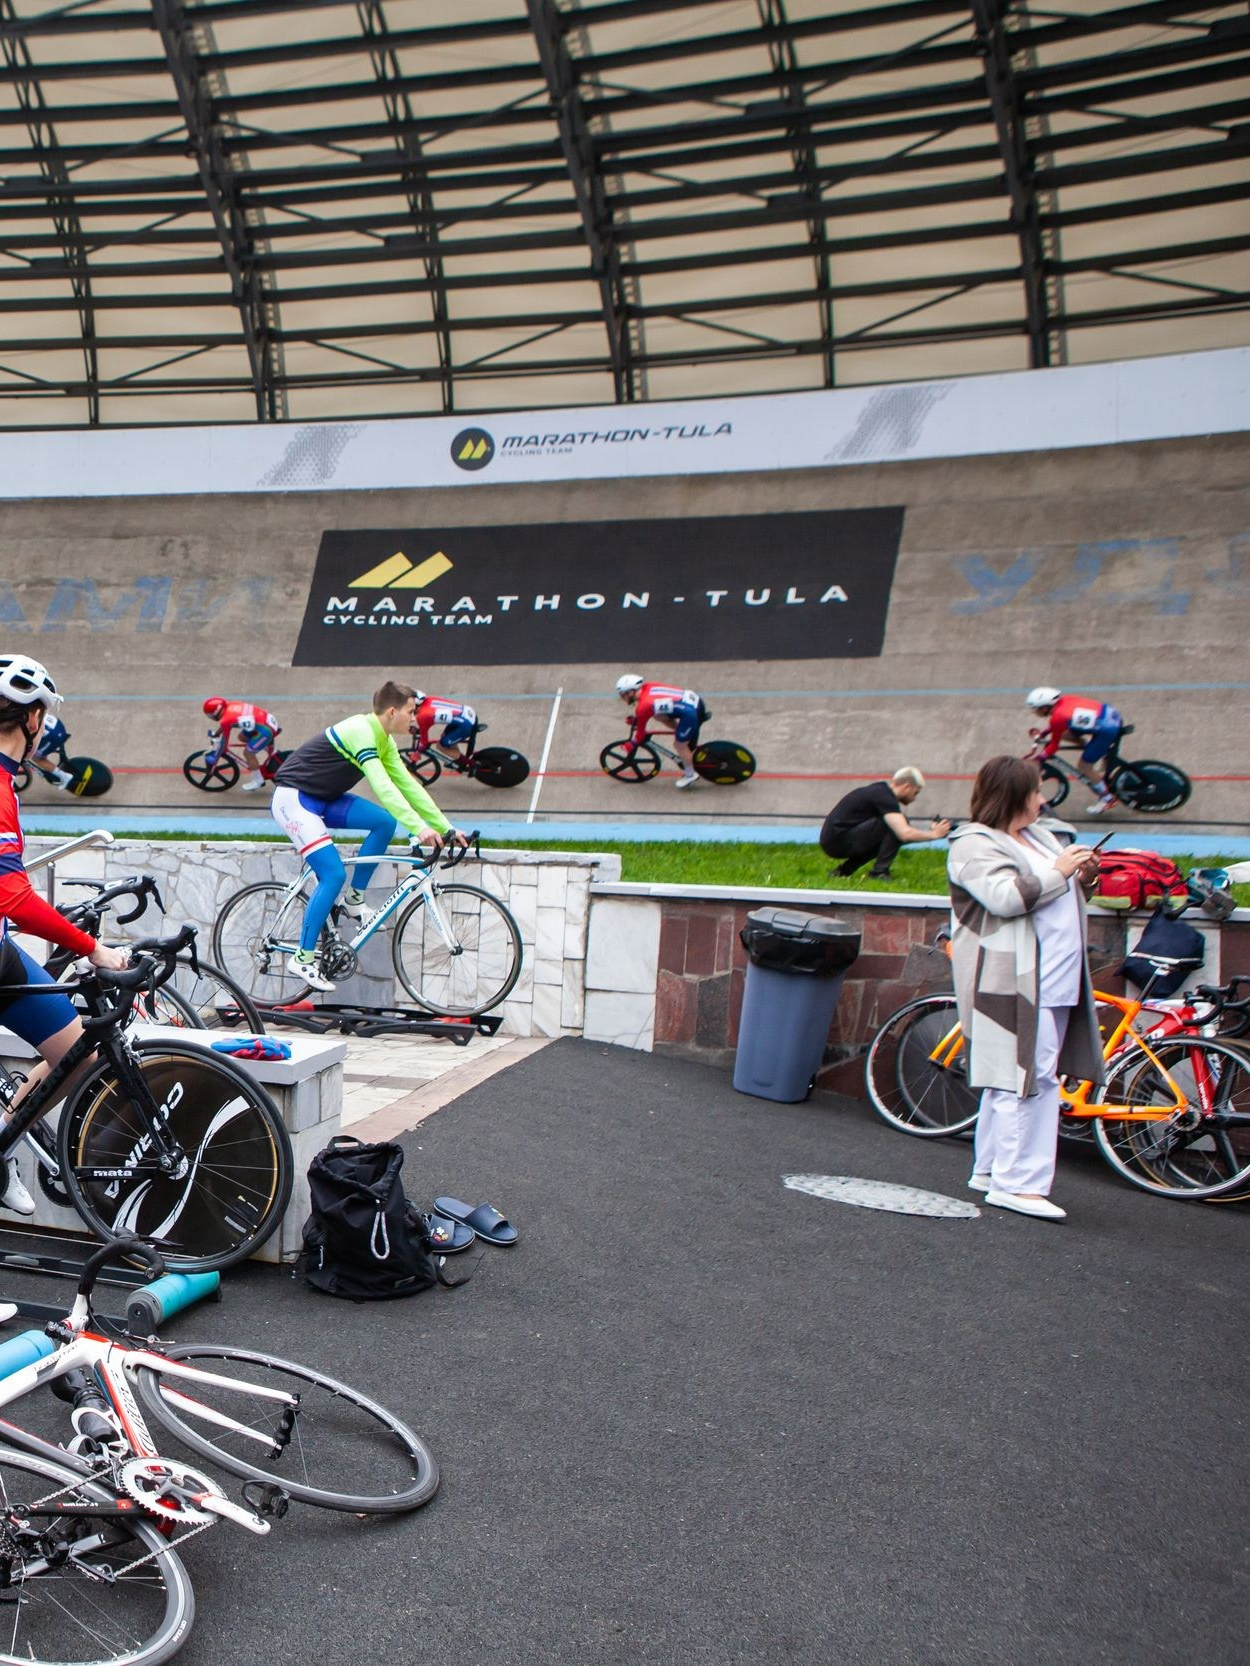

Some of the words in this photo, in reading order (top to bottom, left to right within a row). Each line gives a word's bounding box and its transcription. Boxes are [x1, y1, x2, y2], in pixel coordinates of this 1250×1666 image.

[502, 422, 734, 449] MARATHON-TULA
[322, 614, 419, 626] CYCLING
[430, 613, 493, 625] TEAM
[93, 1168, 134, 1178] mata
